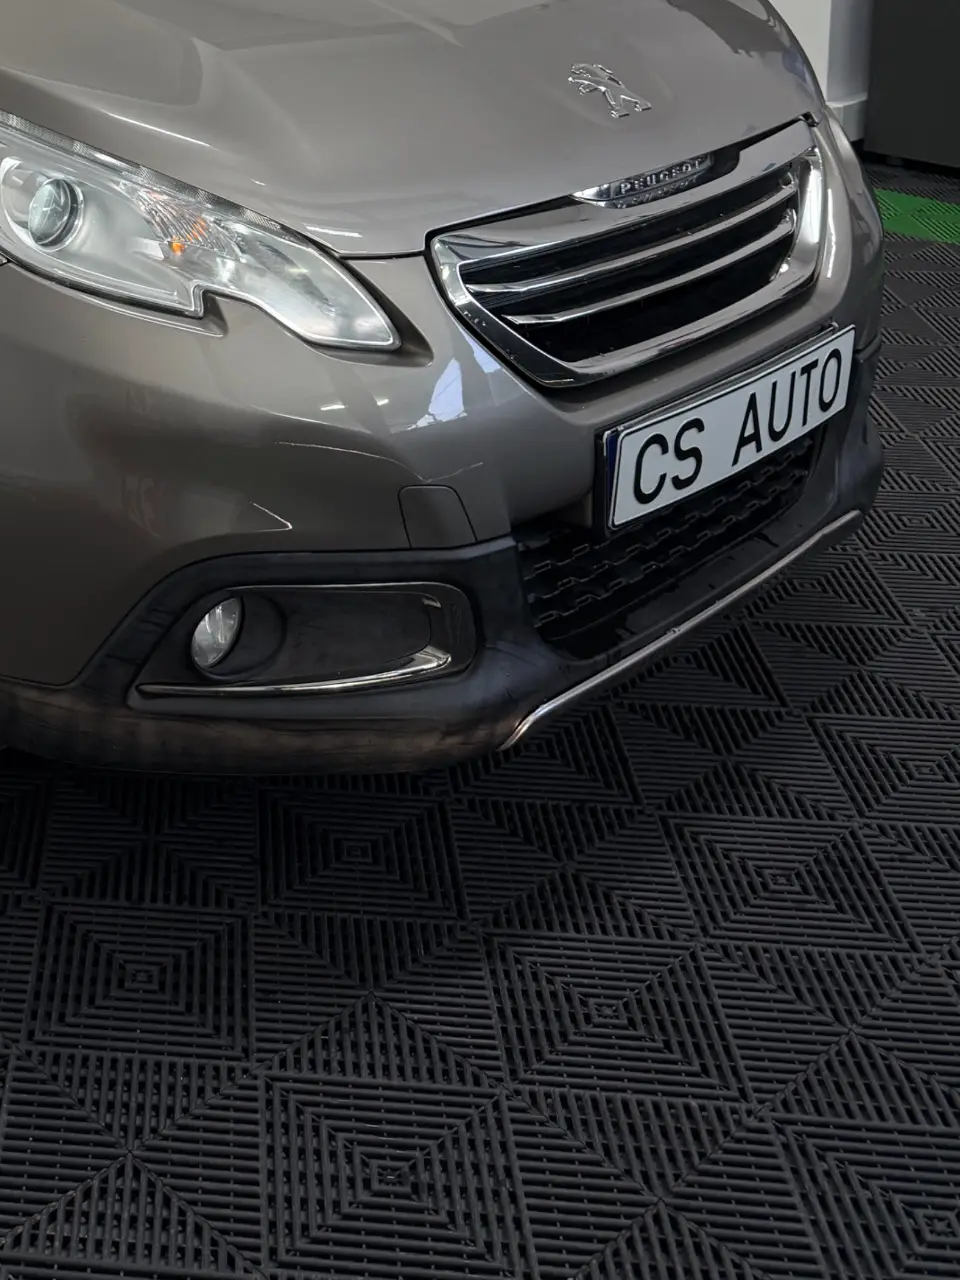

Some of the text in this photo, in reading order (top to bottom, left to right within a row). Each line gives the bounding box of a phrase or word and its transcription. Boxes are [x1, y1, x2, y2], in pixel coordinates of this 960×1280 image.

[620, 158, 703, 195] PEUGEOT
[633, 348, 842, 504] CS AUTO
